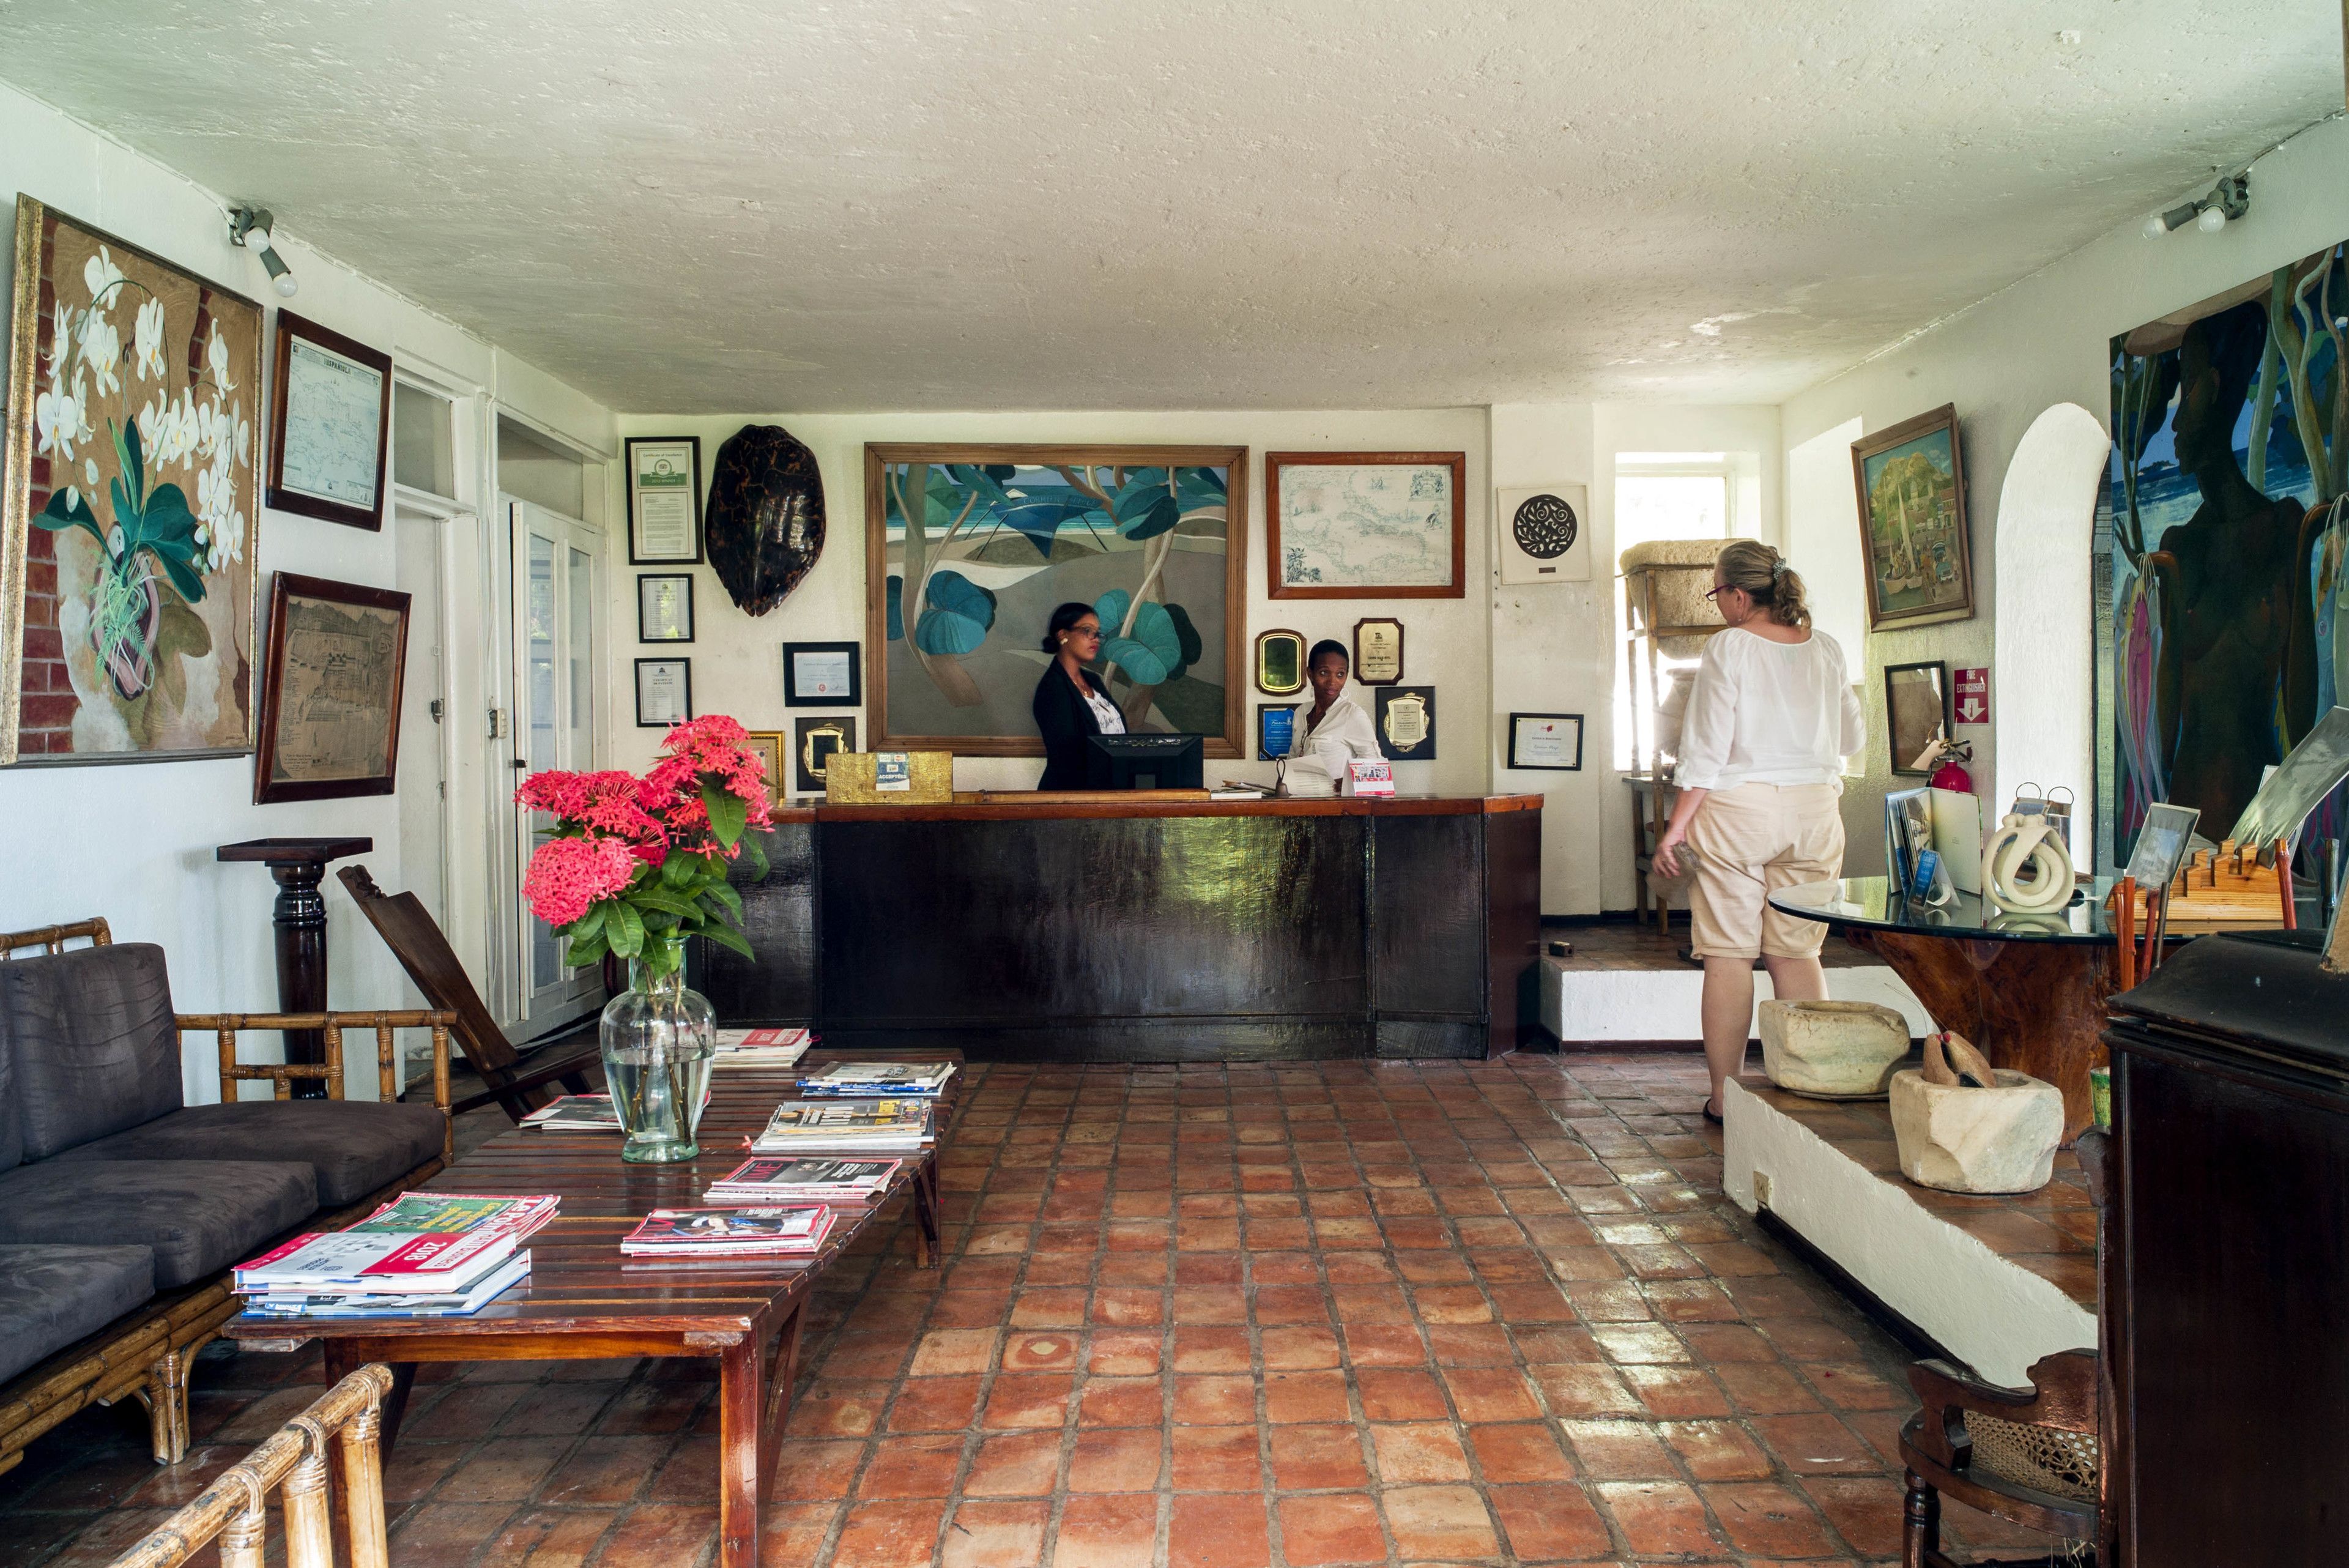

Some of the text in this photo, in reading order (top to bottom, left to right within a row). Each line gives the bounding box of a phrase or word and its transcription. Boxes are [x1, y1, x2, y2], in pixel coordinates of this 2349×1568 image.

[324, 357, 351, 375] HISPANIOLA
[1966, 669, 1976, 680] FIRE
[1957, 682, 1986, 693] EXTINGUISHER
[737, 1163, 783, 1183] TIME
[473, 1212, 525, 1233] Poin
[404, 1242, 447, 1260] 2018
